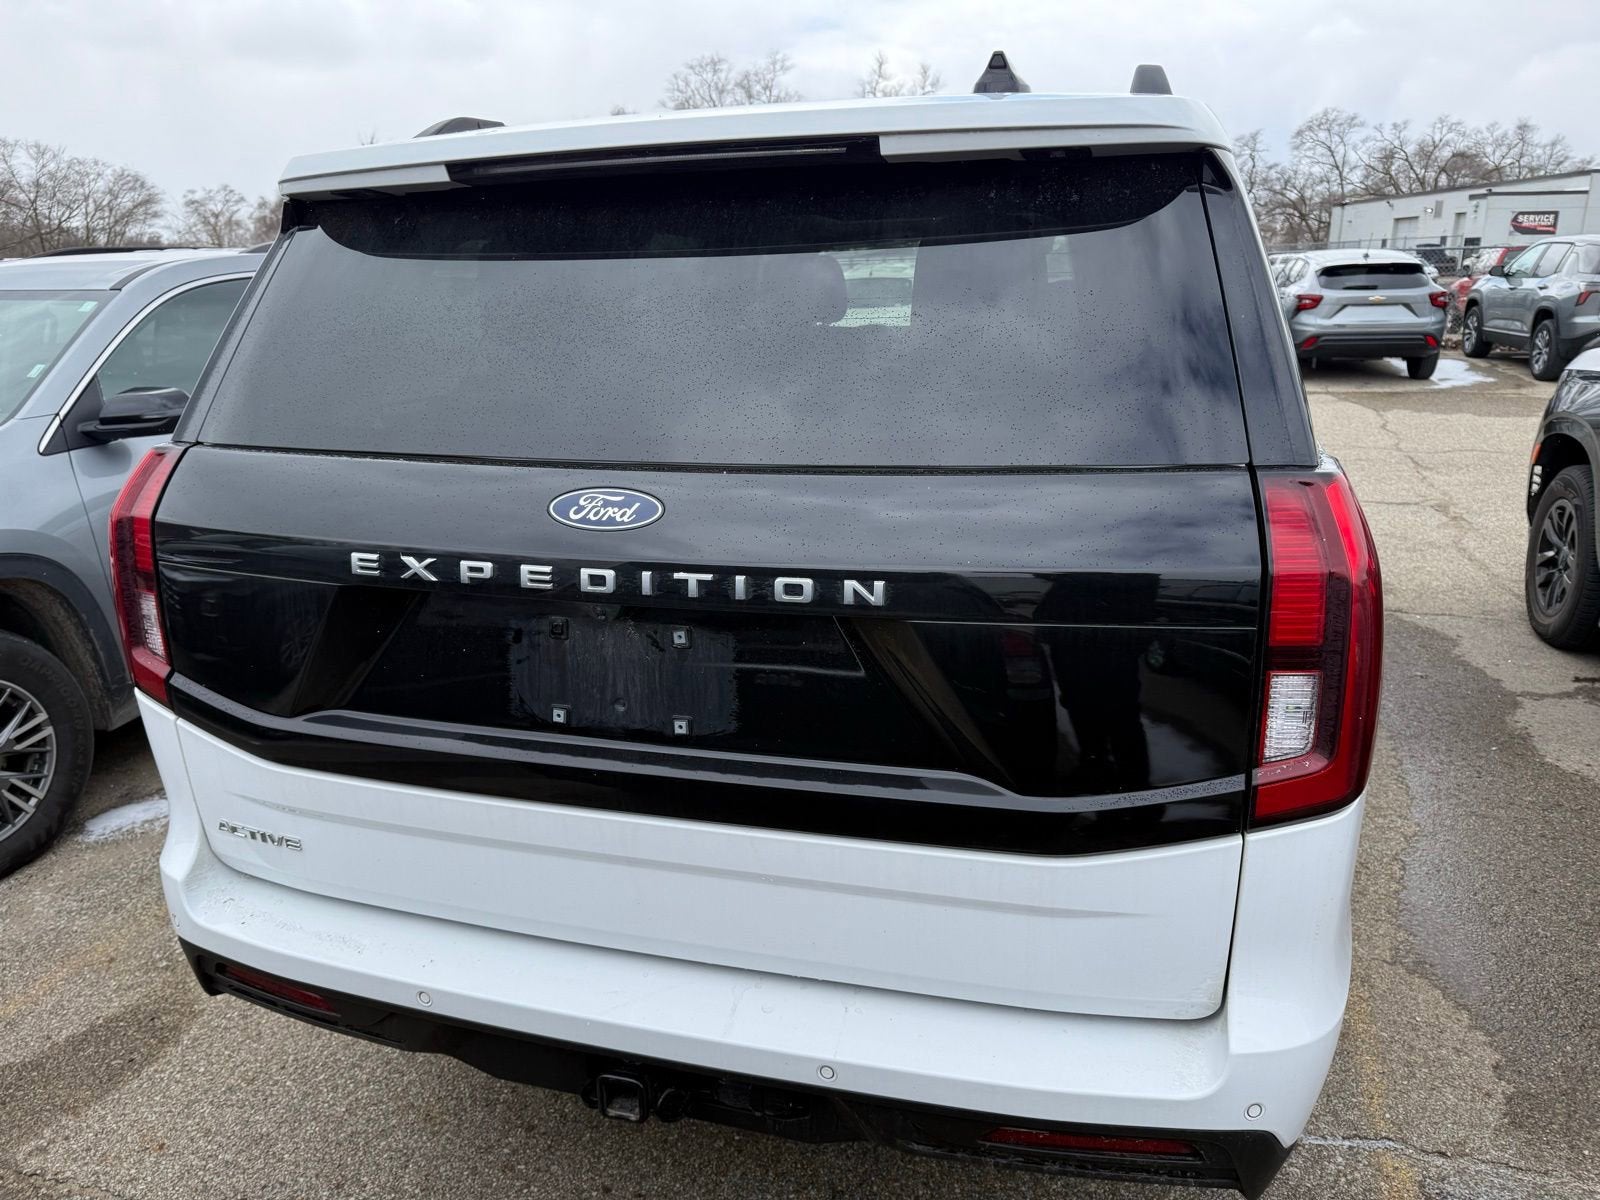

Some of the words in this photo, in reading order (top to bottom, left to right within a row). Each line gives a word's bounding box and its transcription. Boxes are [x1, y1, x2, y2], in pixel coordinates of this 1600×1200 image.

[1517, 214, 1556, 222] SERVICE
[569, 493, 641, 522] Ford
[350, 552, 886, 607] EXPEDITION
[218, 818, 303, 851] ACTIVE
